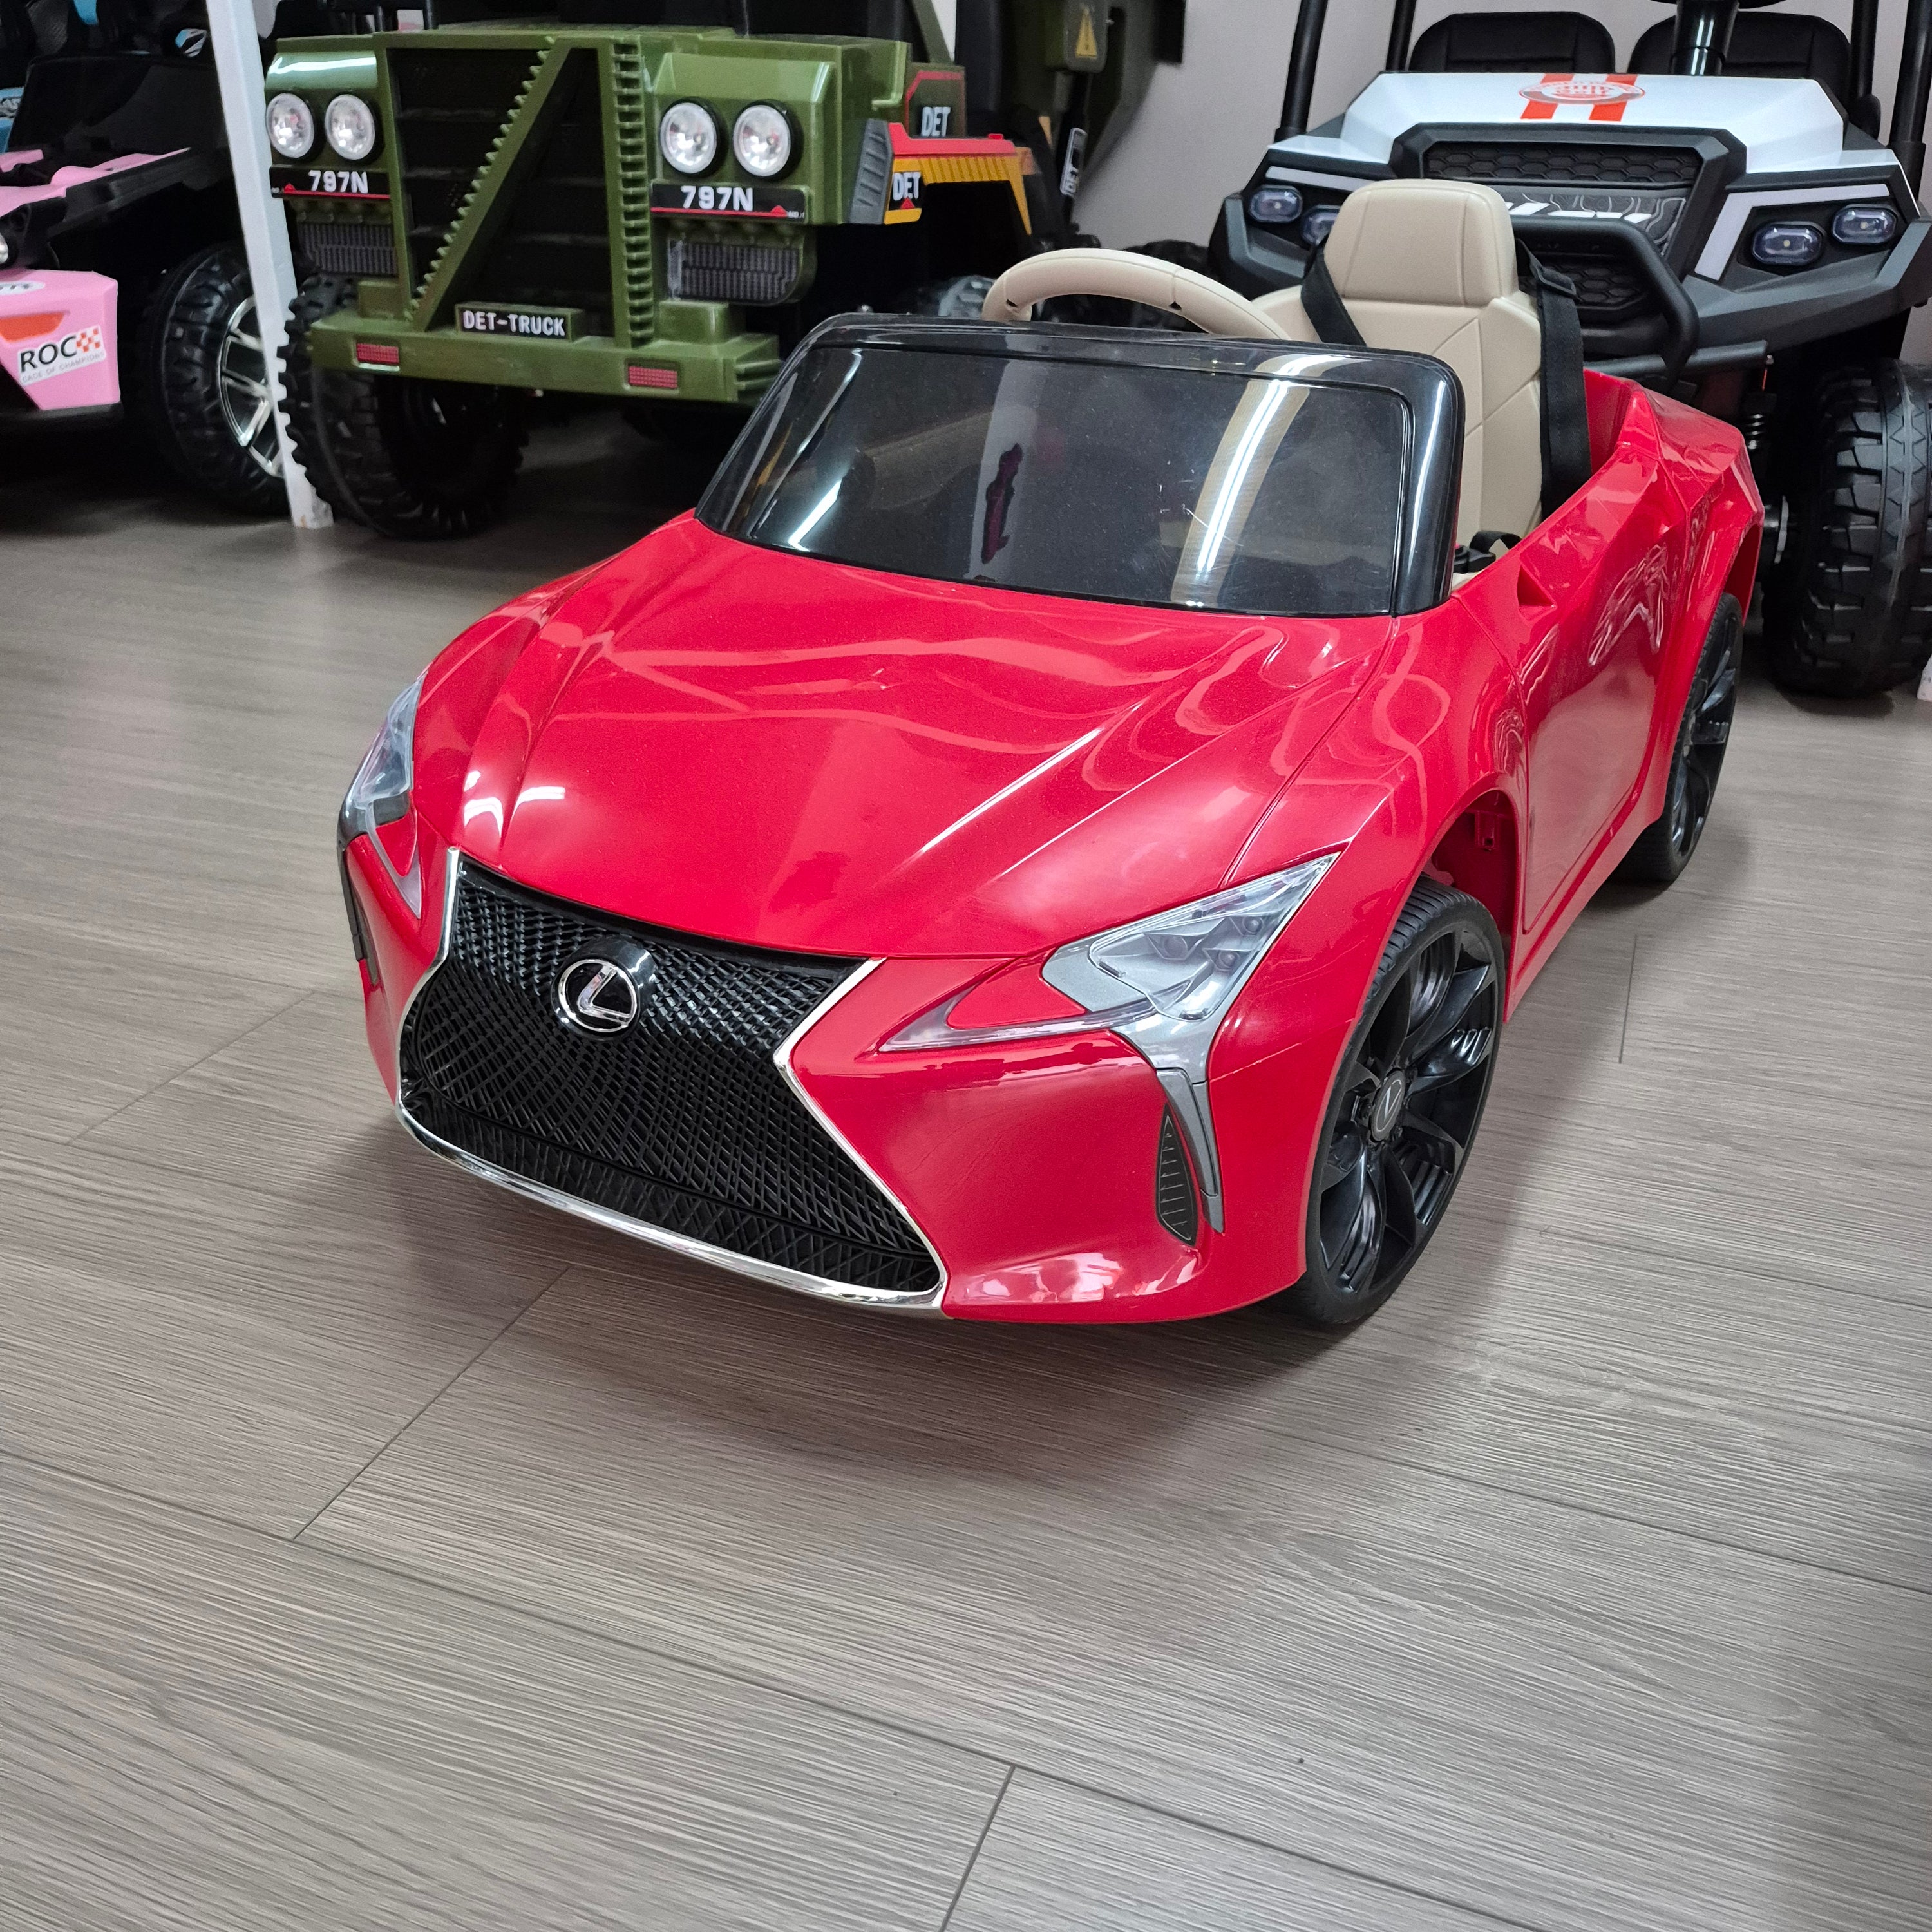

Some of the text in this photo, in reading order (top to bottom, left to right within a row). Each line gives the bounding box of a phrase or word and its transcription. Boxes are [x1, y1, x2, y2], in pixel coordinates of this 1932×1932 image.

[921, 106, 951, 137] DET
[308, 170, 369, 194] 797N
[892, 171, 922, 201] DET
[680, 185, 753, 211] 797N
[462, 310, 565, 337] DET-TRUCK
[20, 336, 78, 372] ROC
